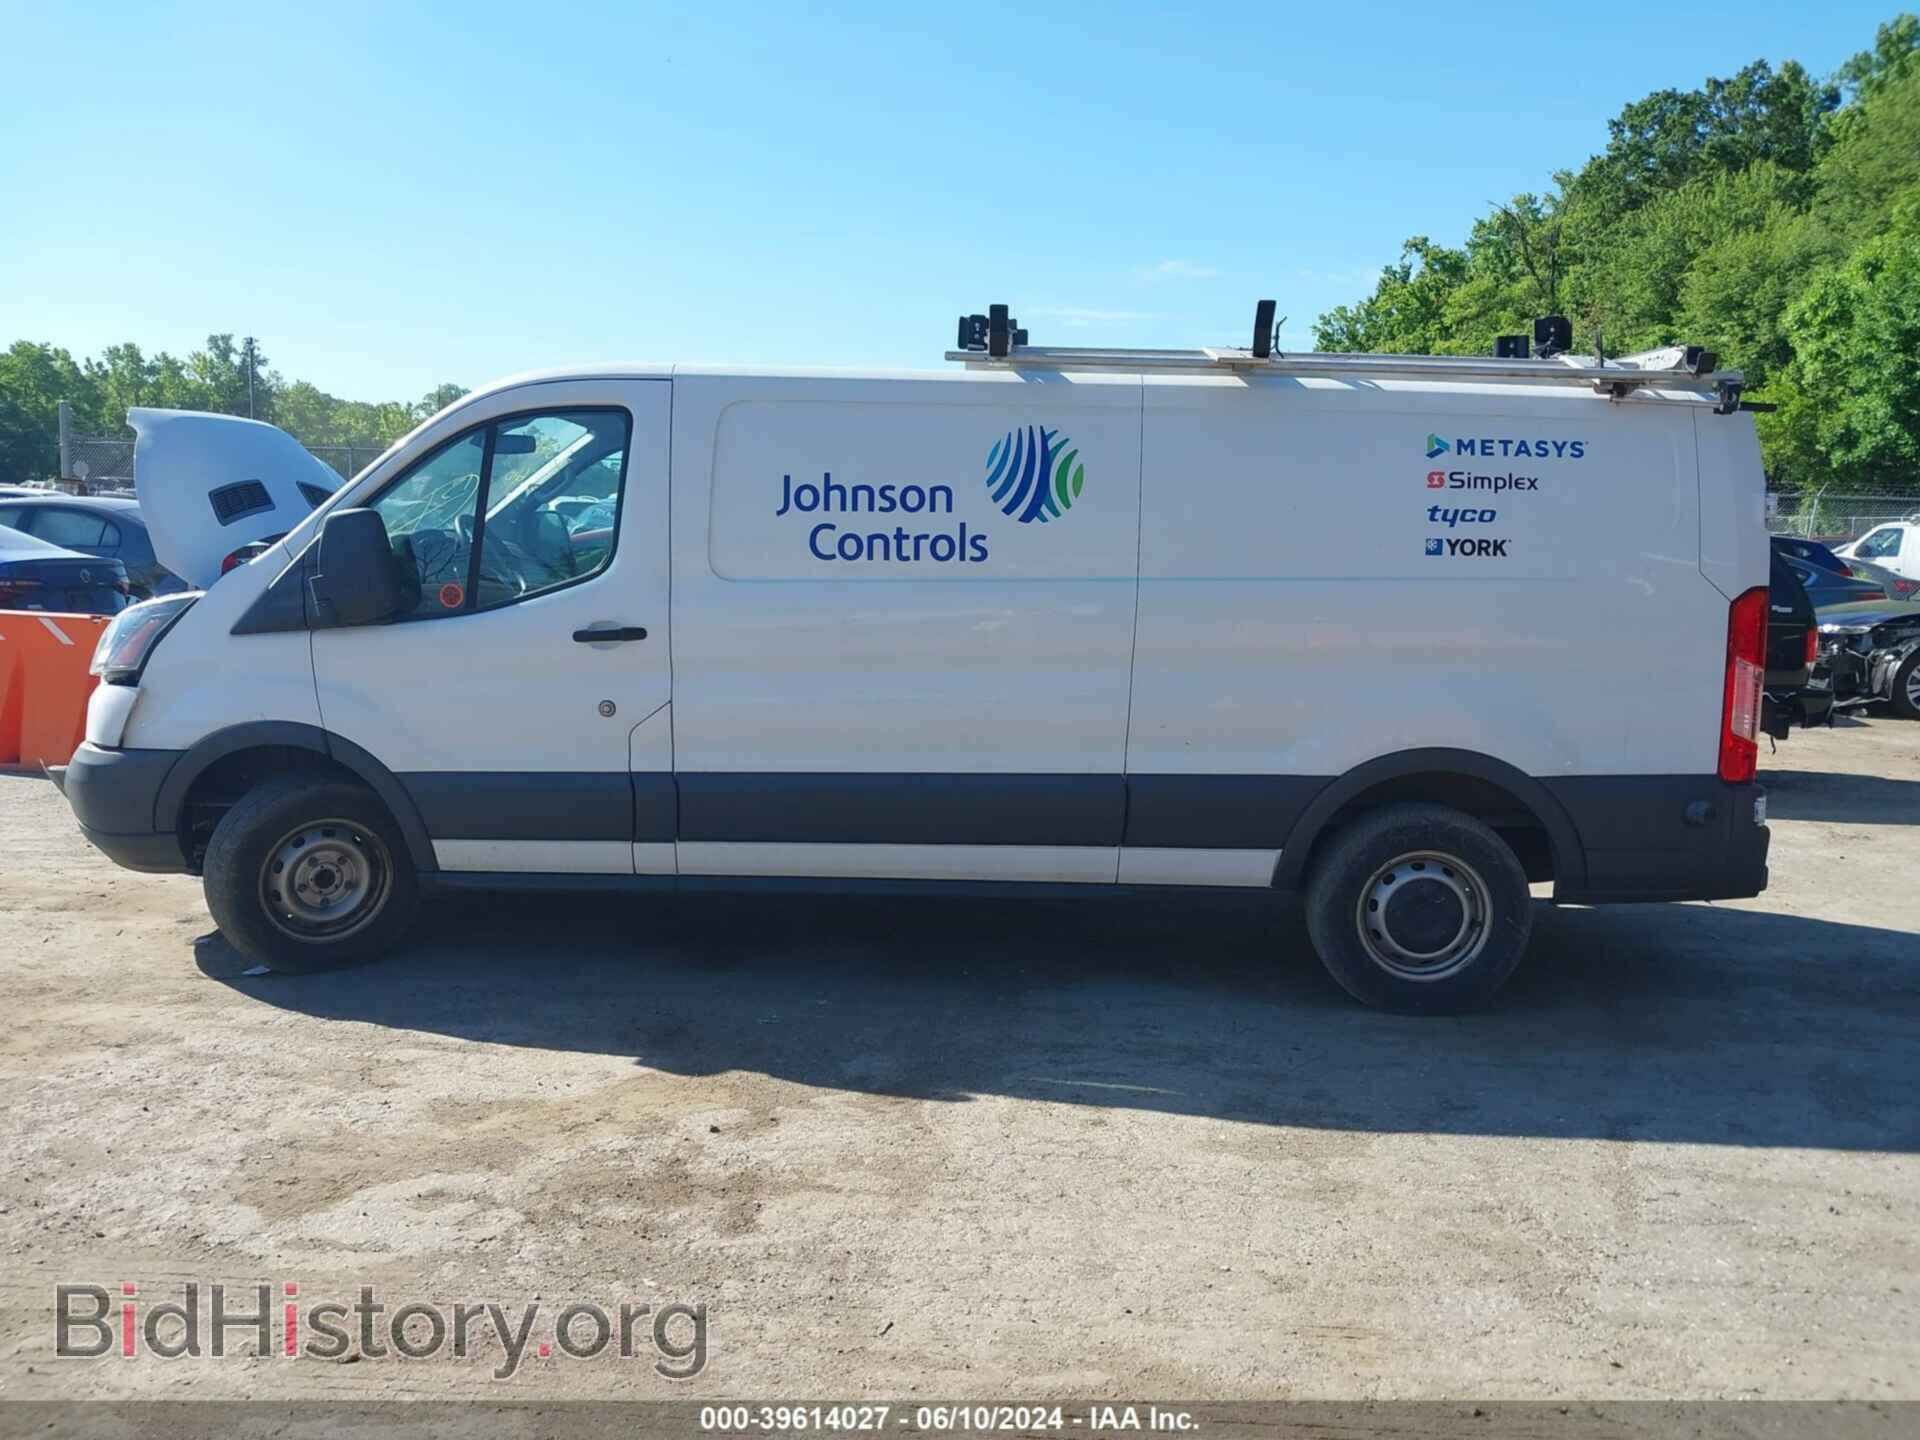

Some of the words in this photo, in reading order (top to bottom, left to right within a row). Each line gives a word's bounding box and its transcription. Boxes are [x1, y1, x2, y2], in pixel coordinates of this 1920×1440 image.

[1456, 438, 1585, 459] METASYS
[776, 472, 953, 516] Johnson
[1448, 471, 1539, 494] Simplex
[1426, 504, 1497, 528] tyco
[808, 521, 989, 562] Controls
[1445, 538, 1507, 557] YORK
